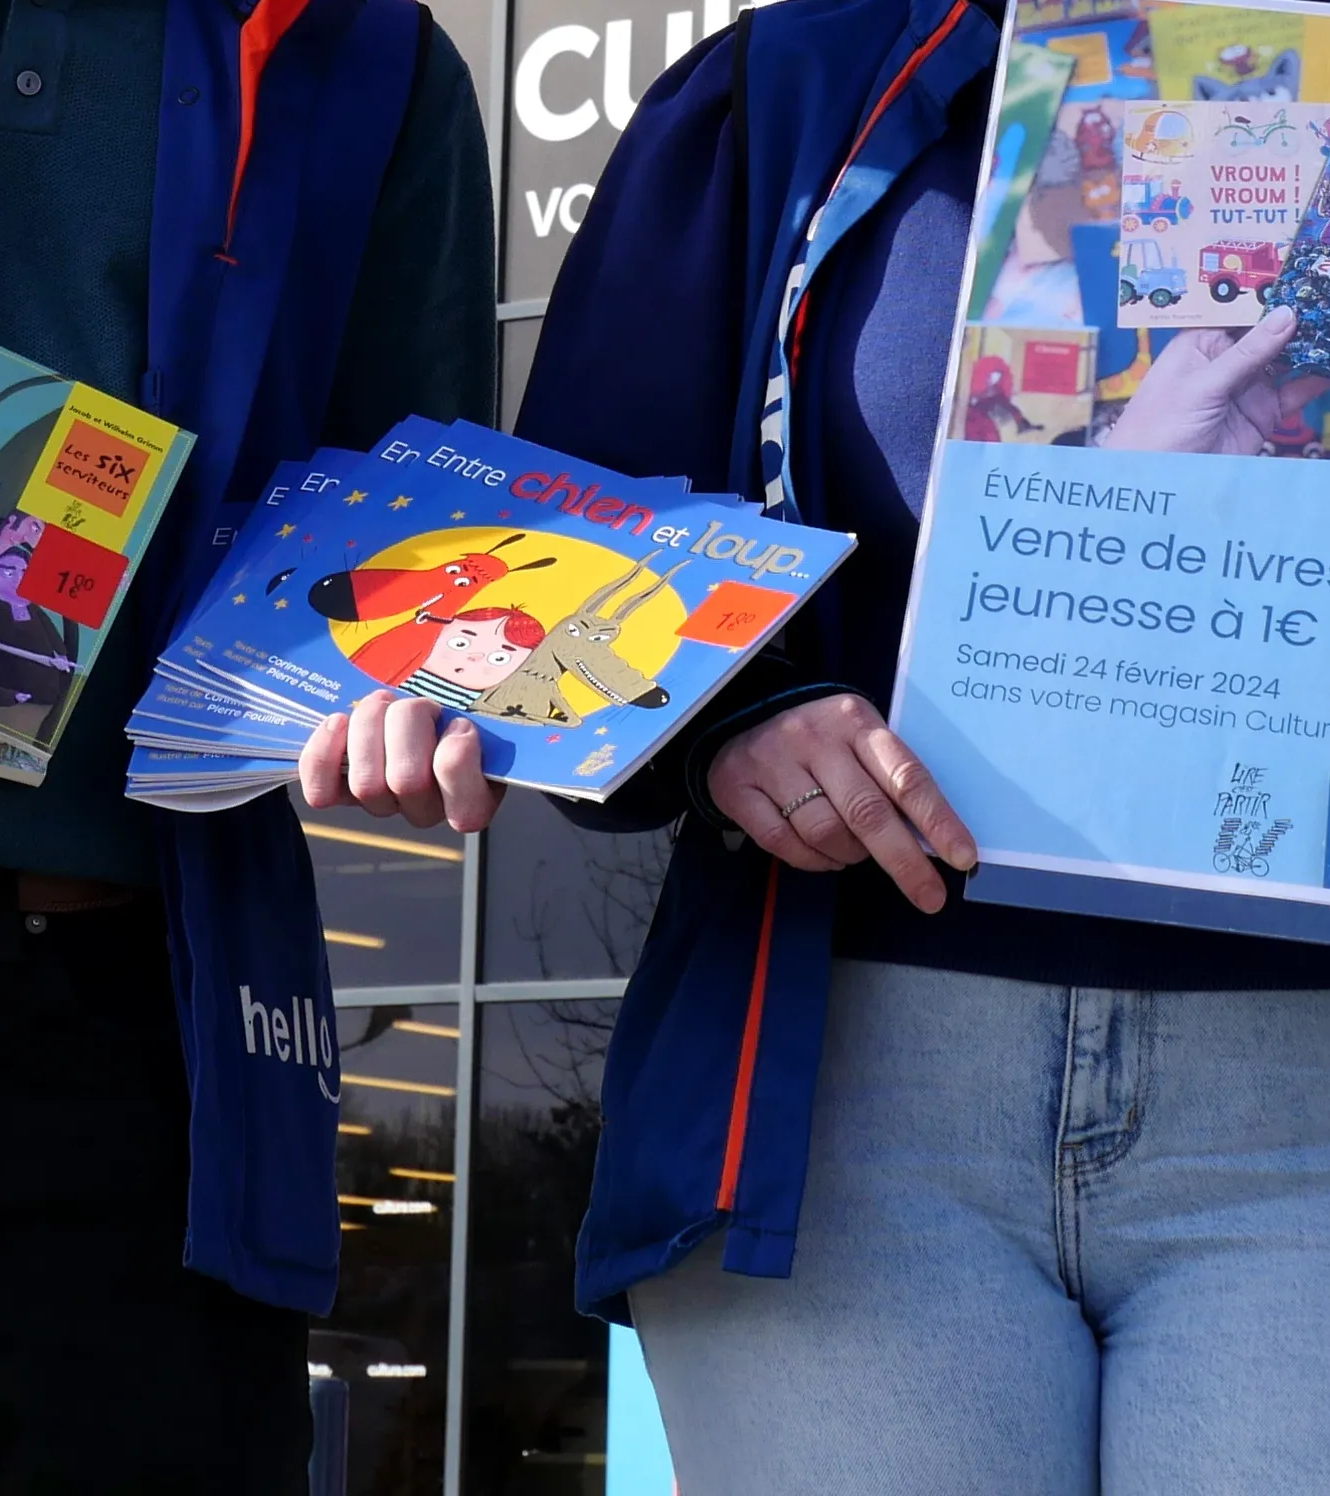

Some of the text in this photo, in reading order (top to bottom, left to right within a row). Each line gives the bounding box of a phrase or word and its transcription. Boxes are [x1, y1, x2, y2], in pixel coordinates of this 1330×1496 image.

[1210, 165, 1286, 182] VROUM
[1210, 187, 1286, 204] VROUM
[1210, 209, 1287, 224] TUT-TUT
[68, 405, 92, 420] Jacob
[103, 419, 135, 440] Wilhelm
[55, 461, 130, 500] serviteurs
[64, 444, 136, 484] Les six
[427, 445, 507, 487] Entre
[509, 470, 656, 536] chien
[651, 524, 691, 548] et
[984, 467, 1176, 515] ÉVÉNEMENT
[979, 515, 1125, 565] Vente
[1140, 534, 1206, 574] de
[960, 571, 1318, 646] jeunesse à 1€
[266, 667, 299, 686] Pierre
[268, 655, 309, 677] Corinne
[956, 643, 1281, 699] Samedi 24 février 2024
[207, 703, 242, 717] Pierre
[951, 676, 1022, 704] dans
[1031, 686, 1102, 713] votre
[1109, 696, 1237, 729] magasin
[1213, 791, 1271, 819] PARTIR
[239, 984, 332, 1069] hello
